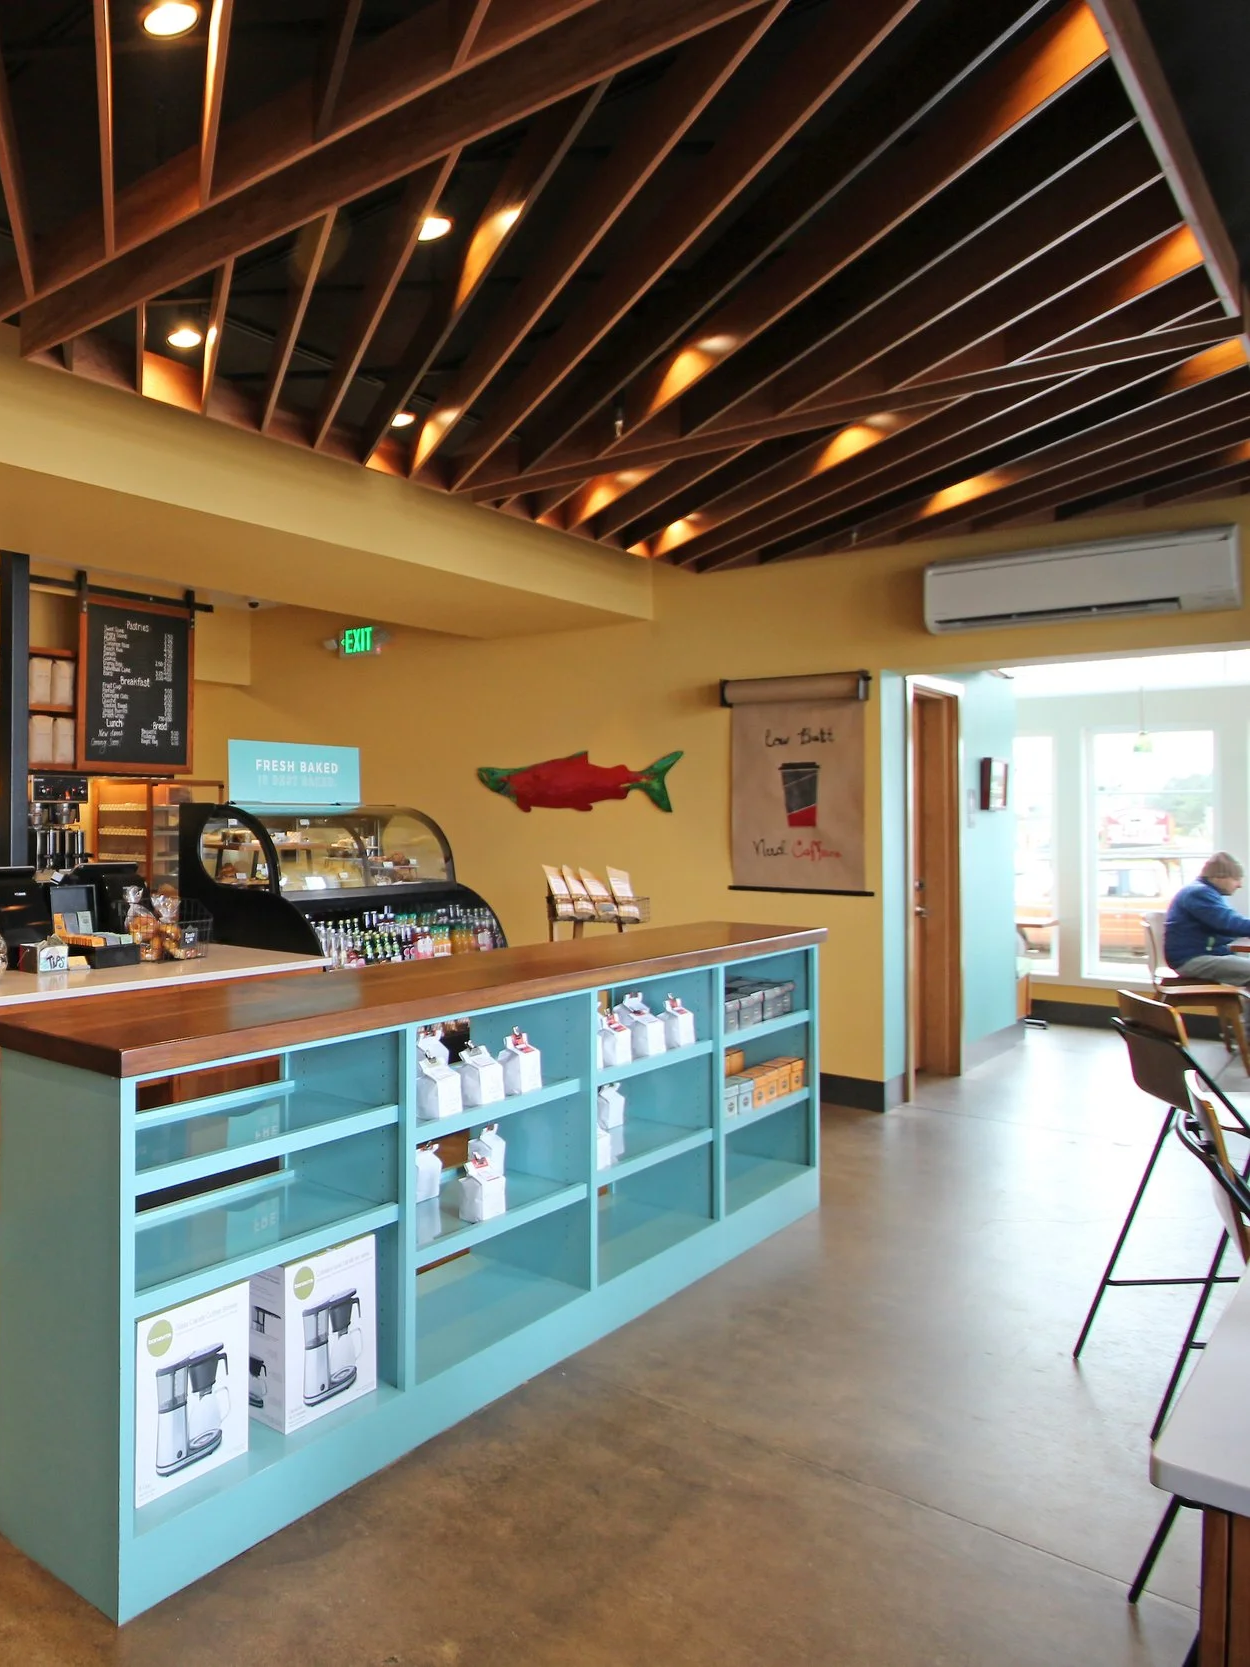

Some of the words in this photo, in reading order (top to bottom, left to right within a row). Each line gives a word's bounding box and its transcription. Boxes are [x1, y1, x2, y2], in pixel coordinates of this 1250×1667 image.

[126, 620, 150, 633] Pastries
[345, 626, 373, 654] EXIT
[120, 675, 150, 687] Breakfast
[105, 718, 124, 728] Lunch
[152, 721, 168, 731] Bread
[764, 728, 790, 747] Low
[255, 759, 295, 772] FRESH
[300, 761, 339, 774] BAKED
[752, 838, 788, 857] Need
